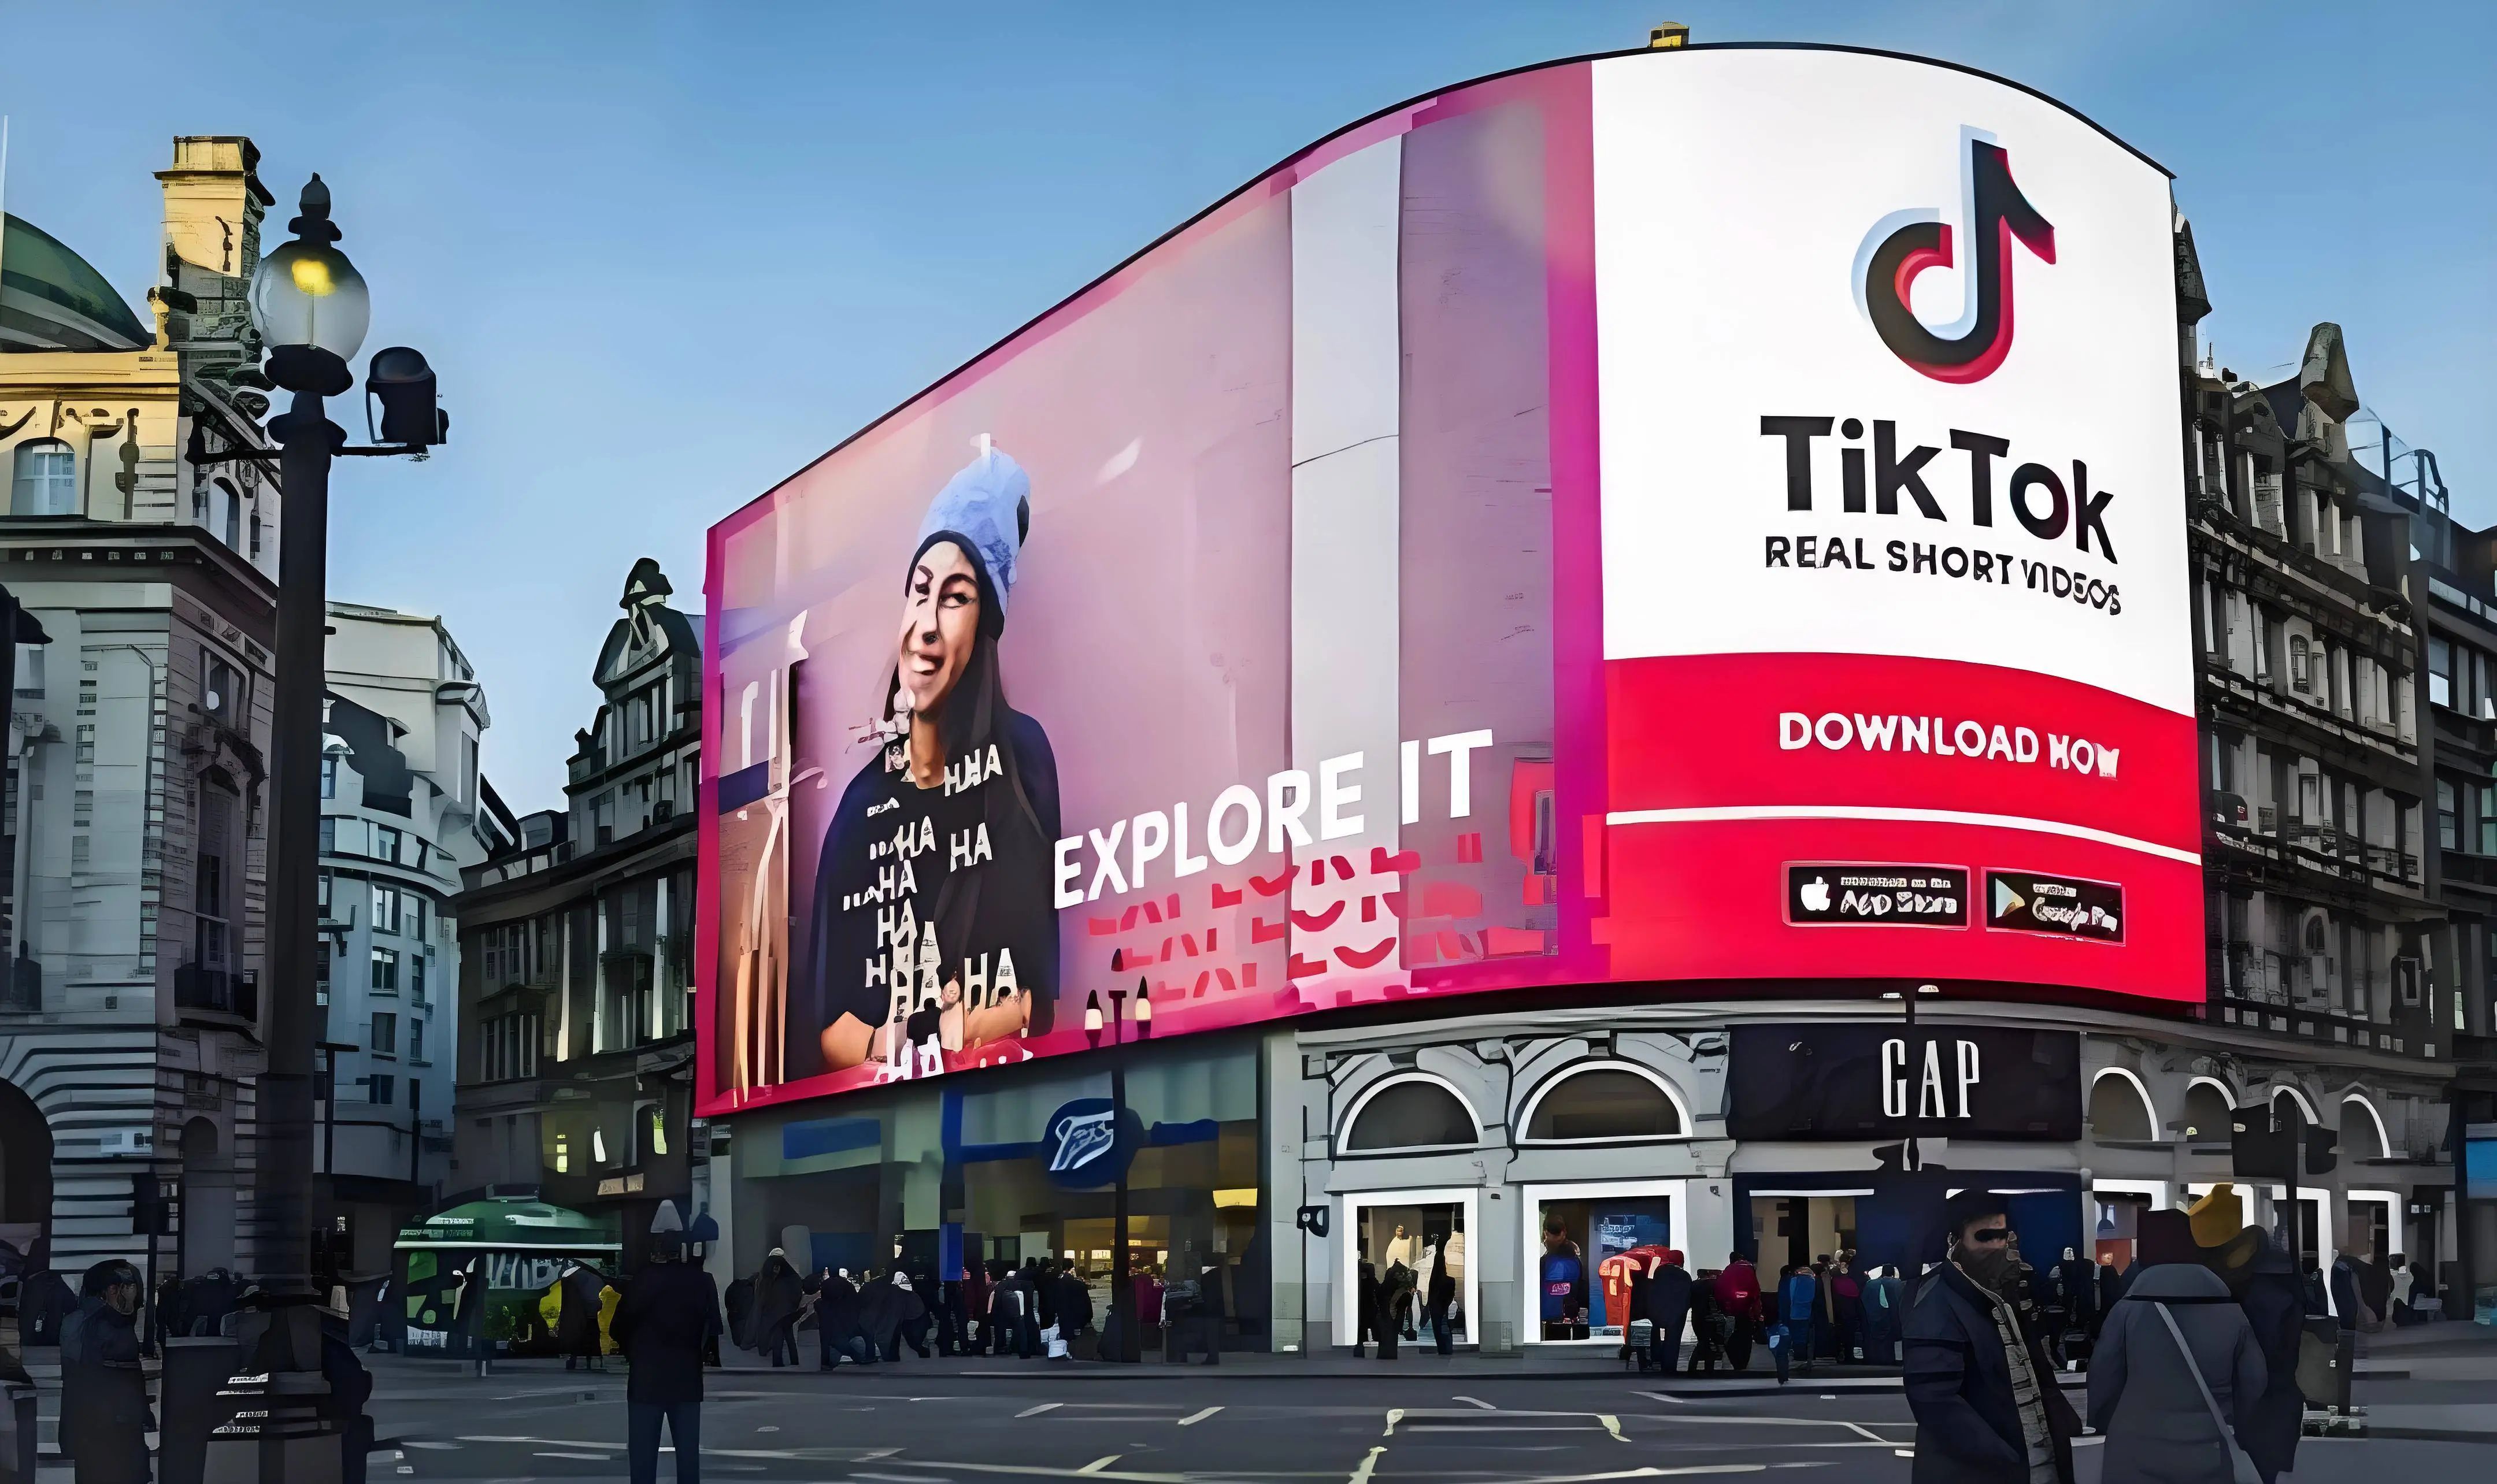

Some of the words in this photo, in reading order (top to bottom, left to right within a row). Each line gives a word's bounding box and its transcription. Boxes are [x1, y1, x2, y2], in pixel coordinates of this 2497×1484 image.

[1760, 415, 2118, 565] TikTok
[1765, 536, 1875, 570] REAL
[1886, 540, 2014, 585] SHORT
[1779, 712, 2039, 763] DOWNLOAD
[950, 822, 993, 873] HA
[1054, 751, 1364, 910] EXPLORE
[1401, 729, 1493, 825] IT
[964, 947, 1018, 1015] HA
[1882, 1038, 1980, 1118] GAP
